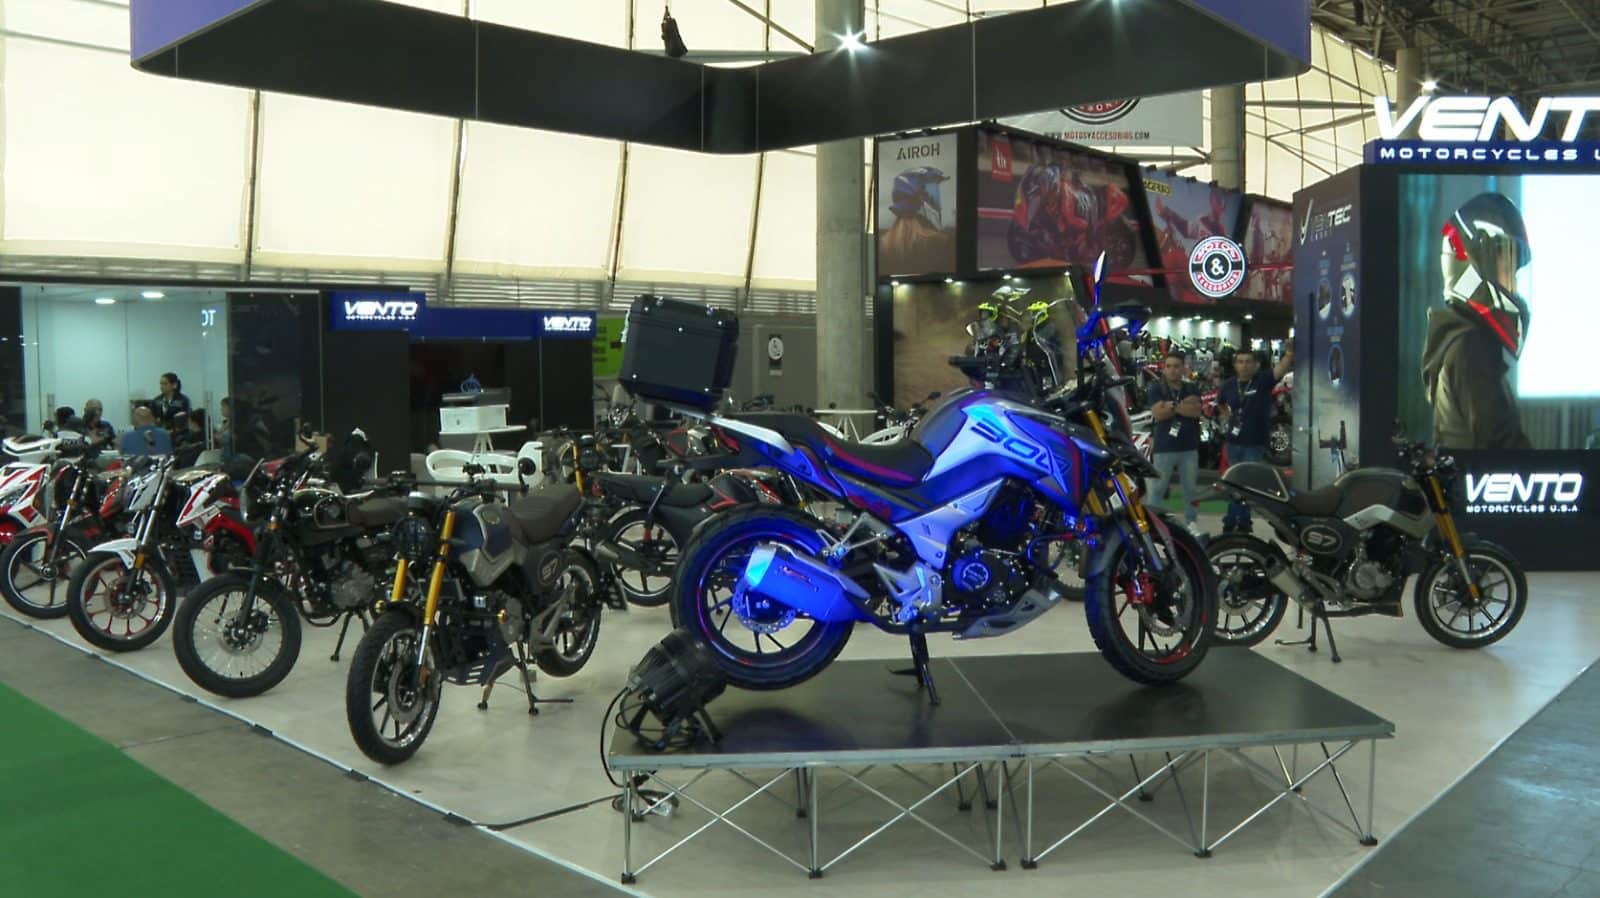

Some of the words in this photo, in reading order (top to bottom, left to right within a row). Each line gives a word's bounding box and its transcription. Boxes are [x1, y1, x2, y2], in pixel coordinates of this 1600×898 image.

[896, 143, 940, 160] AIROH
[1380, 147, 1578, 160] MOTORCYCLES
[1194, 241, 1241, 262] MOTOS
[1211, 258, 1225, 276] &
[344, 301, 418, 316] VENTO
[543, 316, 592, 328] VENTO
[1466, 473, 1583, 503] VENTO
[1466, 505, 1545, 513] MOTORCYCLES
